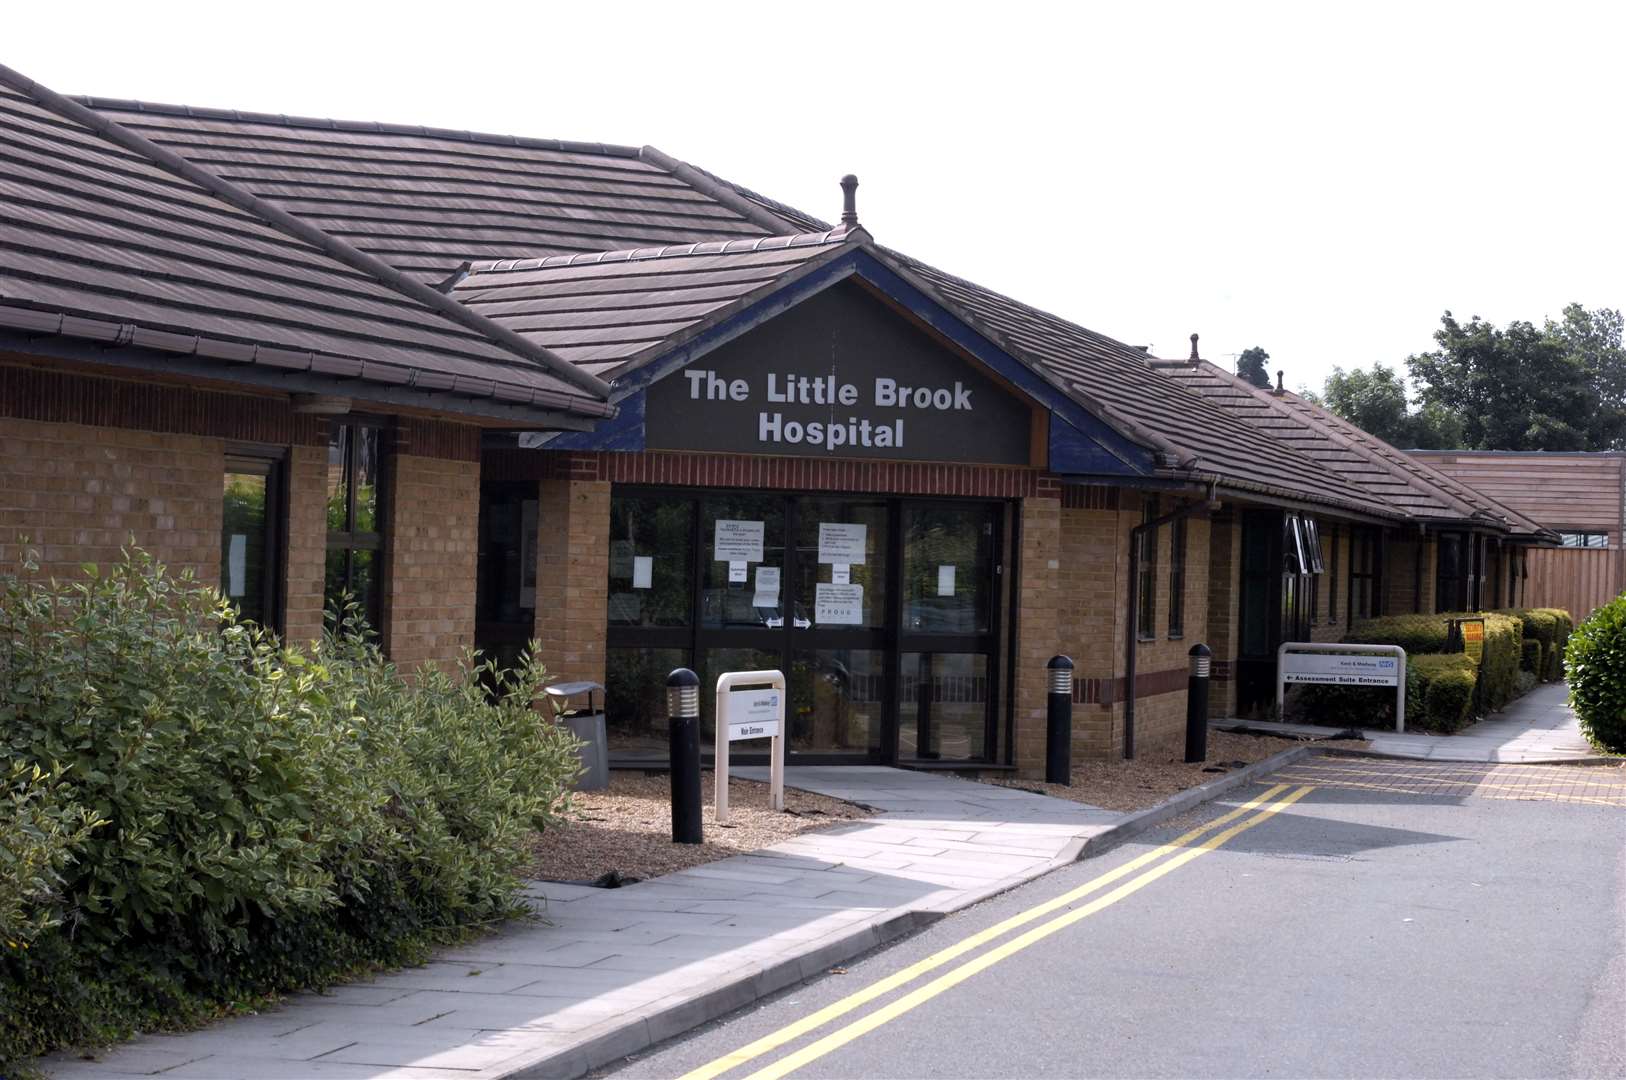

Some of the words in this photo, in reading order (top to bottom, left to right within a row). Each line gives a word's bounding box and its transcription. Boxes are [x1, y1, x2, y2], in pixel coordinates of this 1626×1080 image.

[684, 369, 749, 401] The
[767, 373, 858, 405] Little
[875, 377, 972, 411] Brook
[759, 412, 904, 451] Hospital
